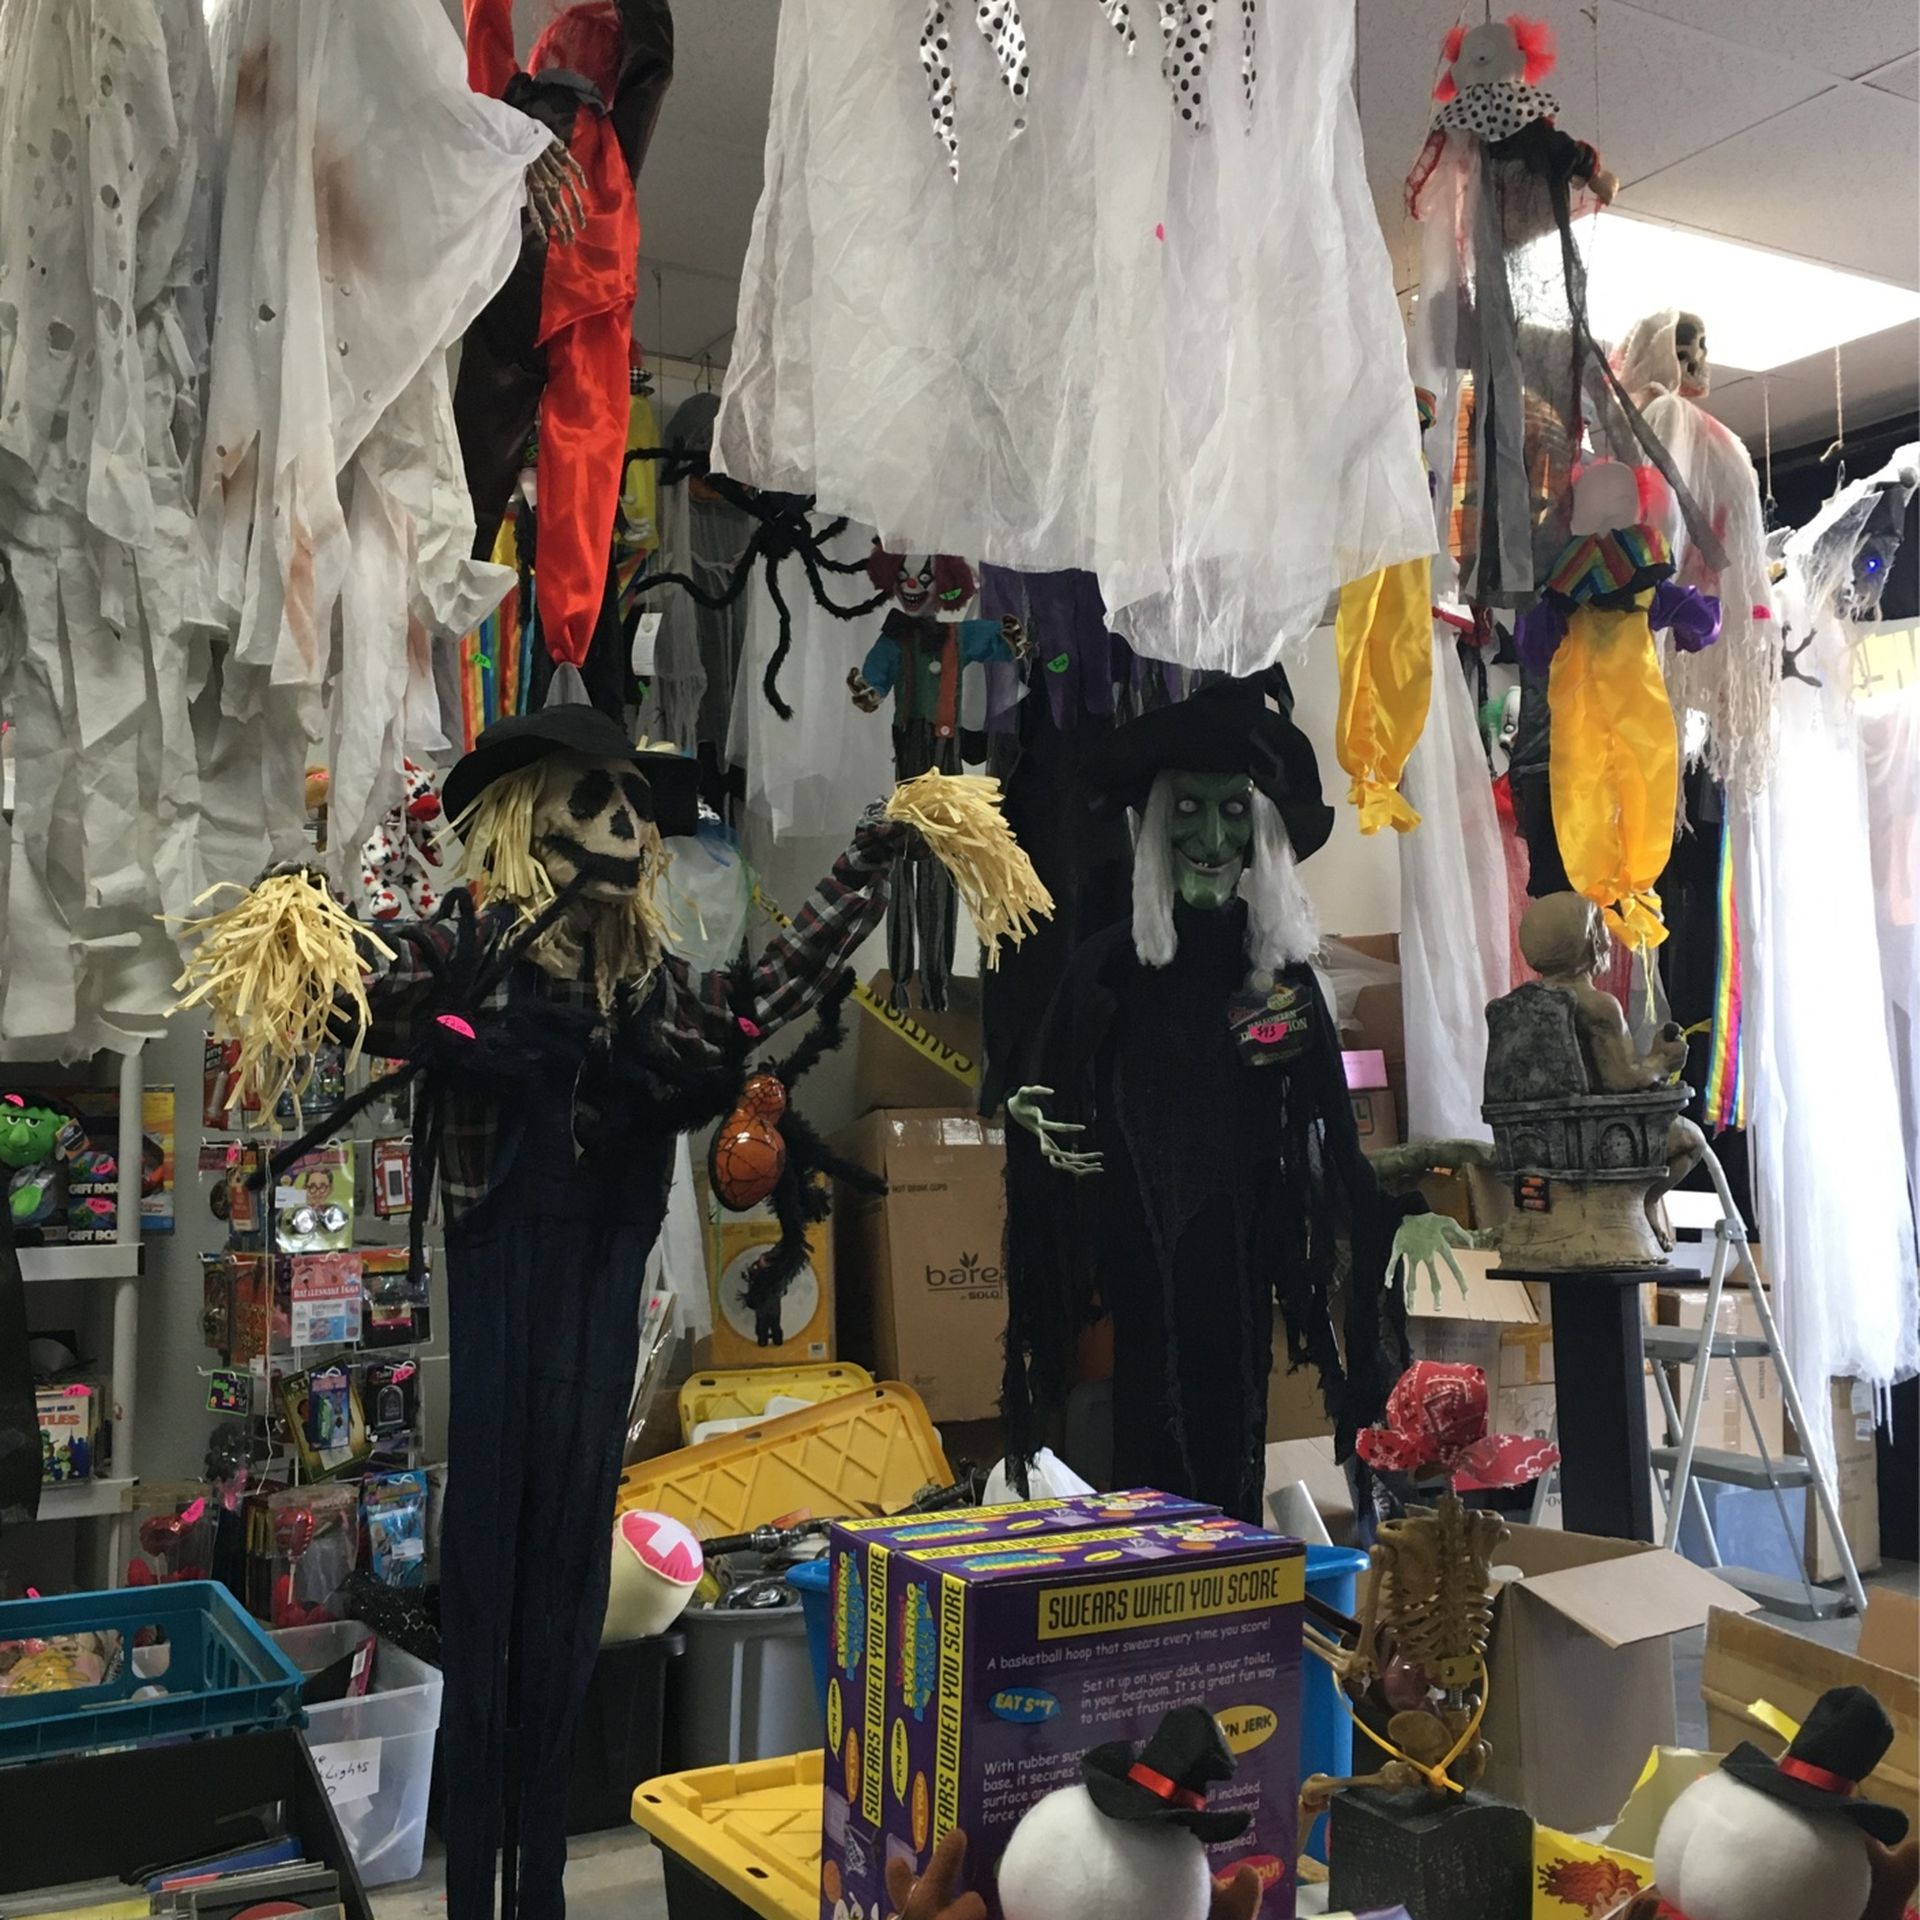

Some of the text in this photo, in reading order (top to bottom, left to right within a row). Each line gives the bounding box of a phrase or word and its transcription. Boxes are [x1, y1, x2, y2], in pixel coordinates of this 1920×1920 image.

[69, 1183, 92, 1194] GIFT
[69, 1230, 92, 1241] GIFT
[926, 1264, 999, 1286] bare
[968, 1290, 999, 1300] SOLO
[1049, 1567, 1280, 1630] SWEARS WHEN YOU SCORE
[943, 1580, 963, 1653] SCORE
[903, 1582, 916, 1707] SWEARING
[987, 1617, 1271, 1670] A basketball hoop that swears every time you score!
[865, 1548, 887, 1820] SWEARS WHEN YOU SCORE
[941, 1655, 961, 1698] YOU
[1082, 1680, 1102, 1694] Set
[1106, 1677, 1115, 1689] it
[1118, 1676, 1131, 1690] up
[1134, 1673, 1147, 1685] on
[1150, 1669, 1173, 1685] your
[1206, 1661, 1217, 1672] in
[1218, 1656, 1241, 1672] your
[1080, 1697, 1092, 1709] in
[1094, 1693, 1119, 1710] your
[1174, 1680, 1197, 1694] It's
[1199, 1679, 1206, 1689] a
[1207, 1672, 1236, 1691] great
[1238, 1669, 1256, 1682] fun
[1258, 1666, 1278, 1680] way
[994, 1692, 1024, 1711] EAT
[1080, 1713, 1093, 1725] to
[1095, 1707, 1134, 1722] relieve
[1242, 1714, 1273, 1732] JERK
[940, 1704, 959, 1772] WHEN
[983, 1758, 1015, 1776] With
[1018, 1753, 1059, 1770] rubber
[1017, 1774, 1026, 1786] it
[1030, 1766, 1075, 1783] secures
[982, 1790, 1028, 1808] surface
[1218, 1781, 1263, 1798] included.
[982, 1807, 1016, 1825] force
